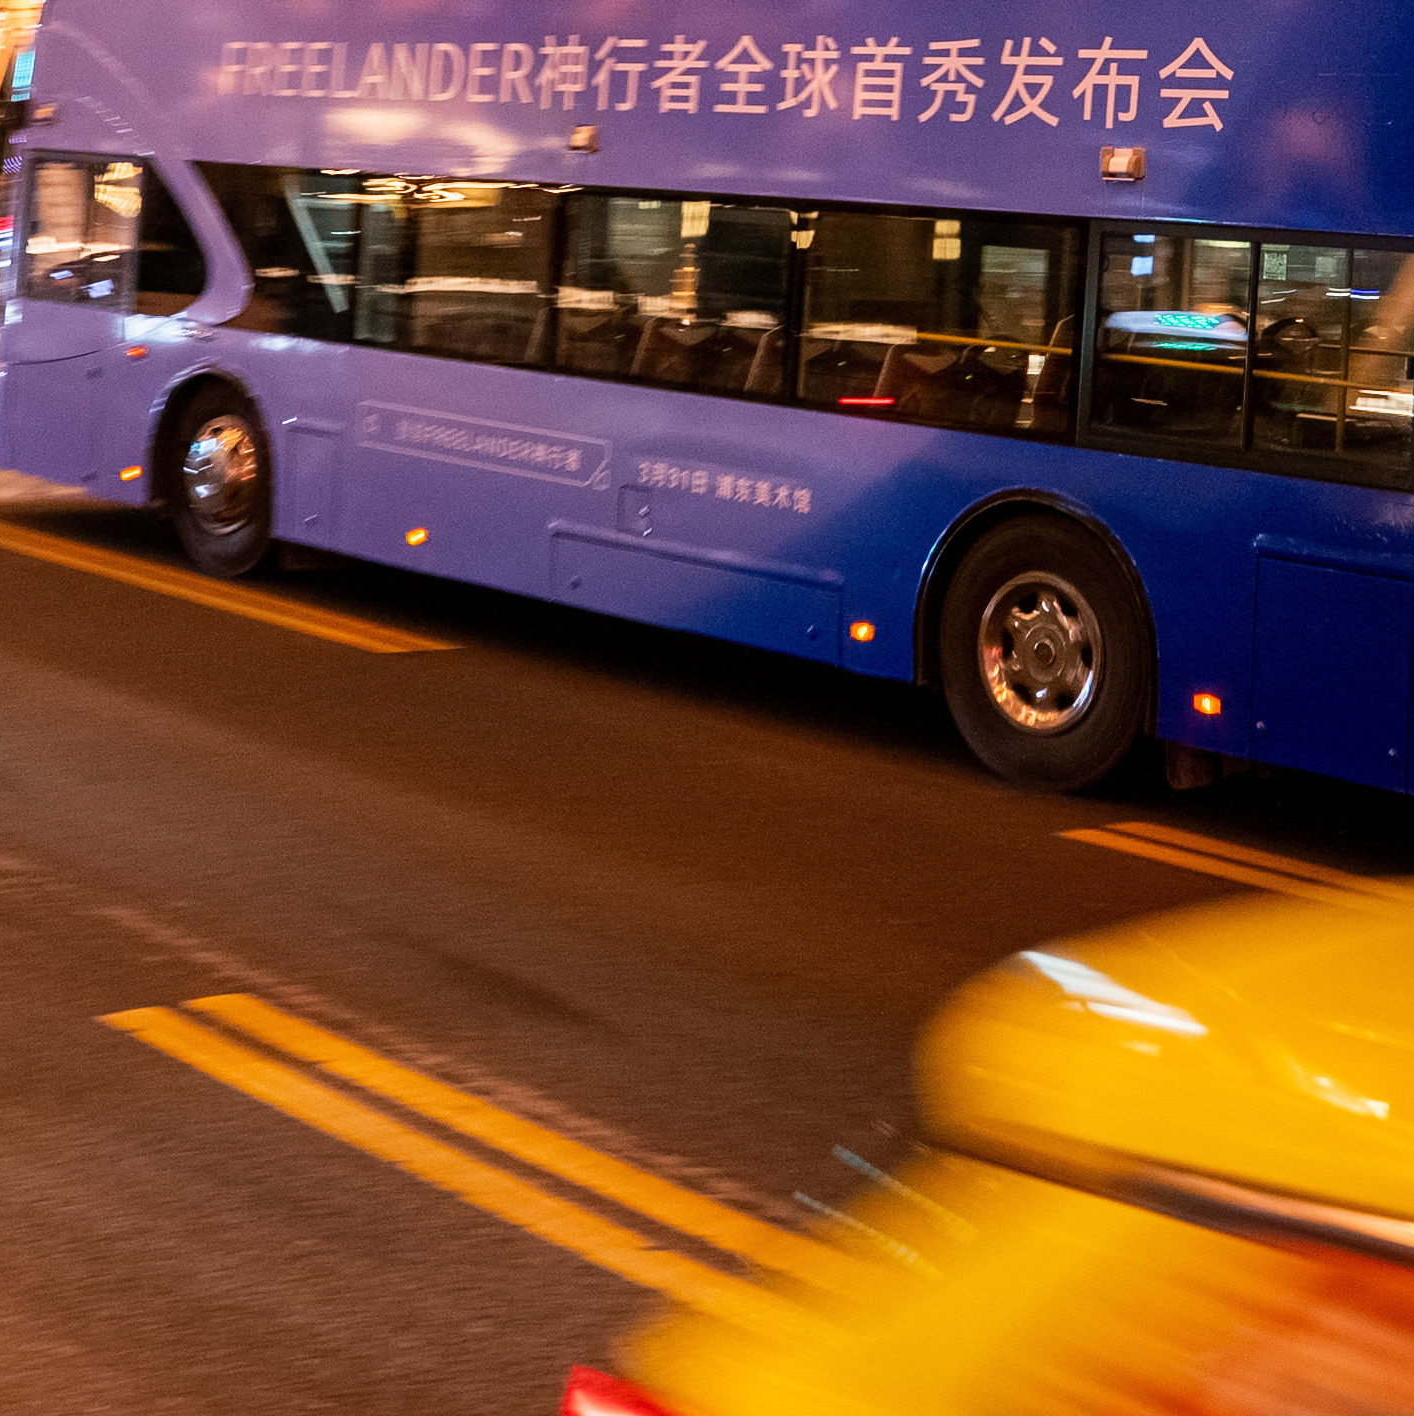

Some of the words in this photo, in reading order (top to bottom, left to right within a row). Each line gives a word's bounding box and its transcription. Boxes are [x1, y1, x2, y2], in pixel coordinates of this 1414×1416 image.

[219, 33, 1234, 132] FREELANDER神行者全球首秀发布会
